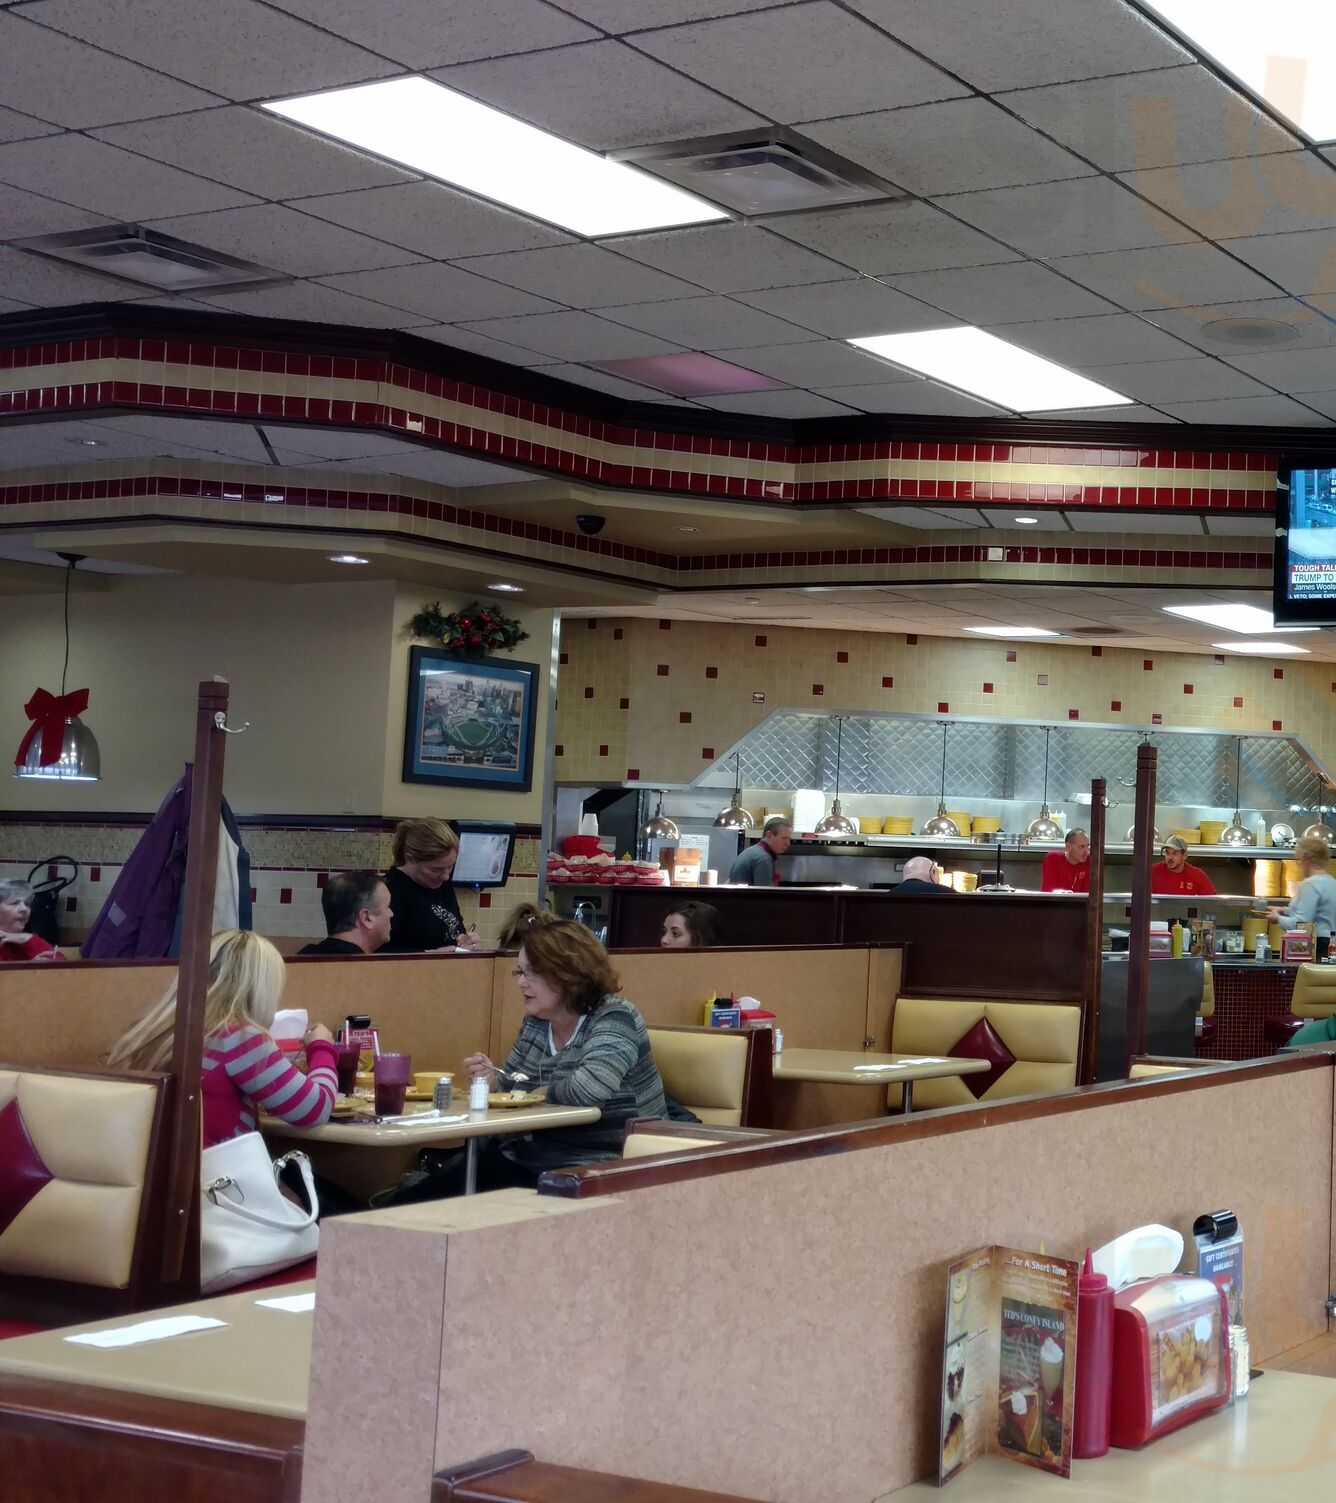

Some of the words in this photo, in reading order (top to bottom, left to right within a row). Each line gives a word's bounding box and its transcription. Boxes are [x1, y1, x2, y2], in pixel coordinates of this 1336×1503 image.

[1294, 564, 1320, 572] TOUGH
[1294, 574, 1322, 582] TRUMP
[1323, 573, 1334, 582] TO
[1024, 1259, 1030, 1268] A
[1030, 1261, 1050, 1273] Short
[1051, 1264, 1068, 1277] Time
[1041, 1317, 1065, 1332] ISLAND
